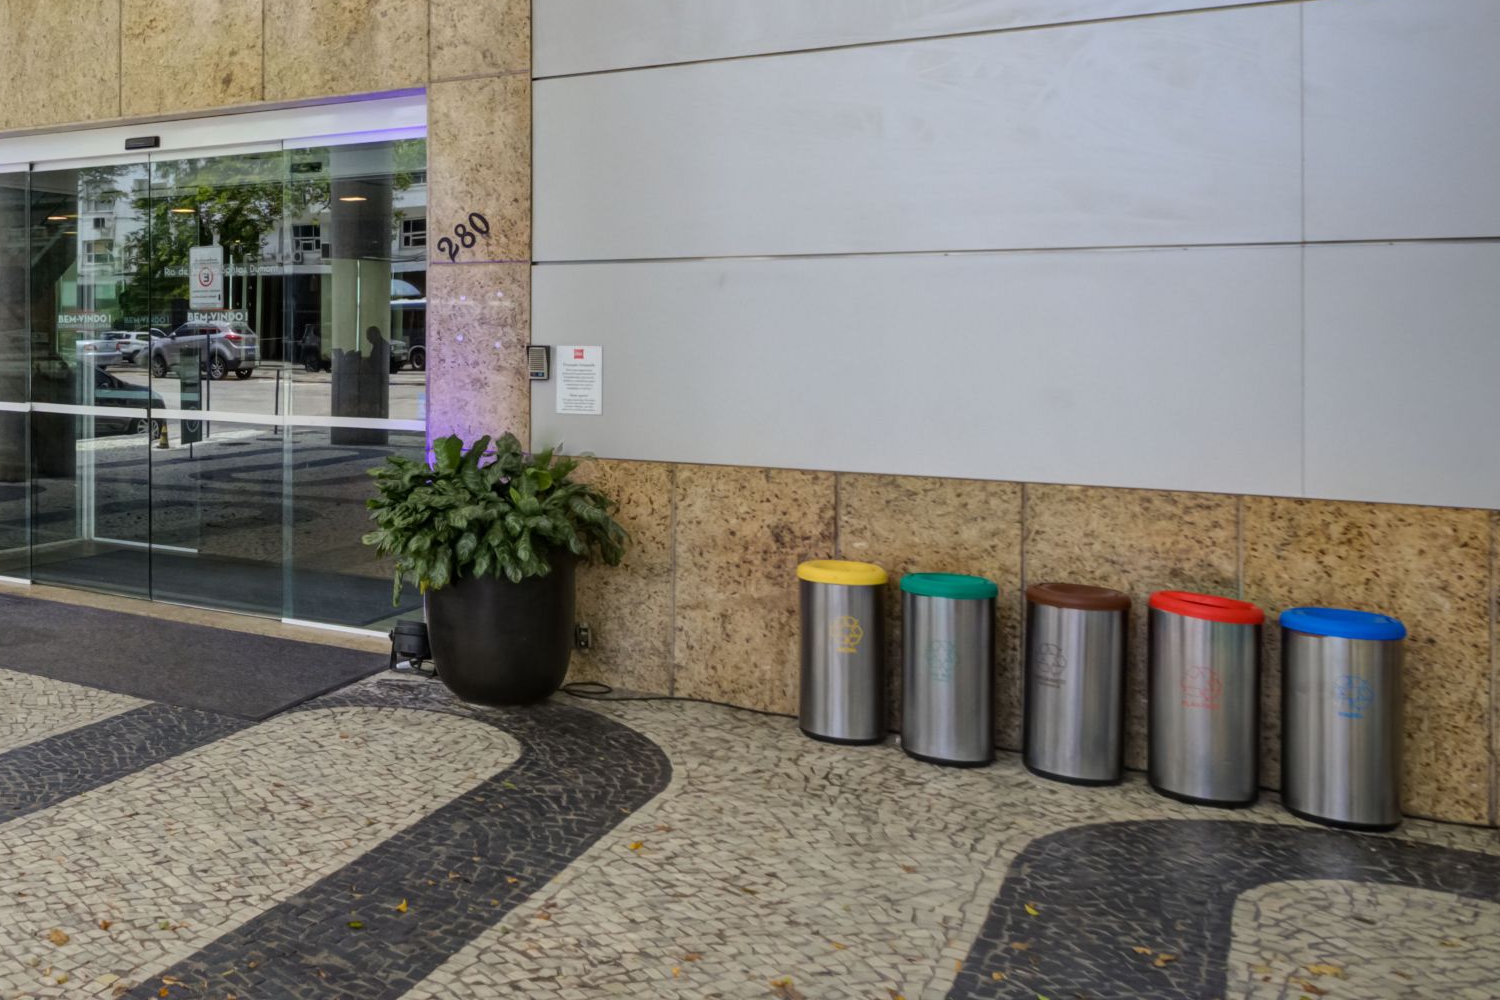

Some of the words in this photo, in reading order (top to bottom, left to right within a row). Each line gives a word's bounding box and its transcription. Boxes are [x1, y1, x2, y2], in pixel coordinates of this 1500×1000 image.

[437, 212, 490, 262] 280
[58, 314, 107, 323] BEM-VINDO
[187, 312, 243, 321] BEM-VINDO
